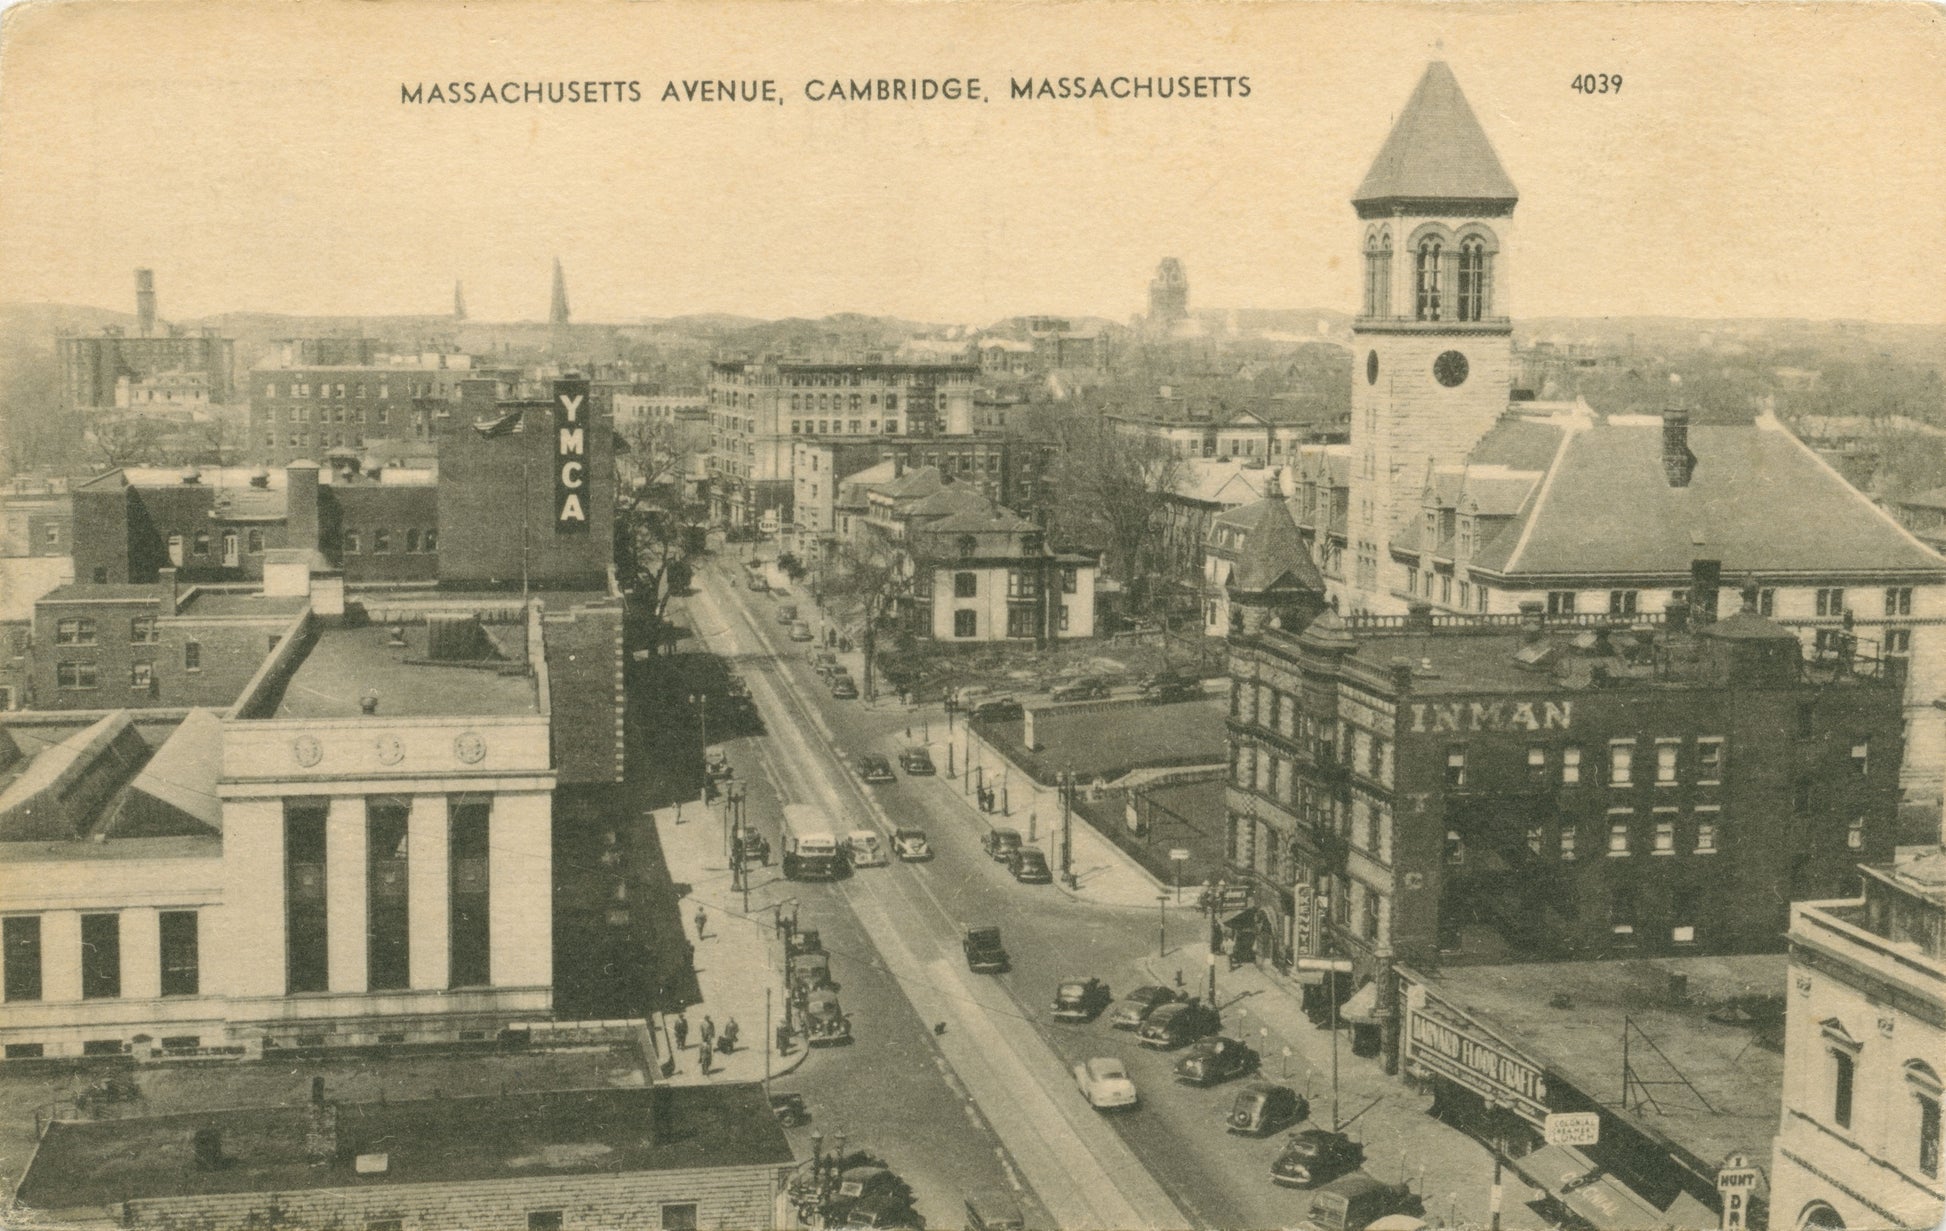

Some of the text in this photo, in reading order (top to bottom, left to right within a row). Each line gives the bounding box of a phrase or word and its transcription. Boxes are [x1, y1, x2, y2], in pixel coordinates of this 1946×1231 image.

[559, 395, 585, 521] YMCA
[1411, 701, 1571, 732] INMAN
[1462, 1039, 1499, 1080] FLOOR
[1500, 1058, 1535, 1097] CRAFT
[1552, 1133, 1594, 1143] LUNCH
[1720, 1173, 1755, 1187] HUNT
